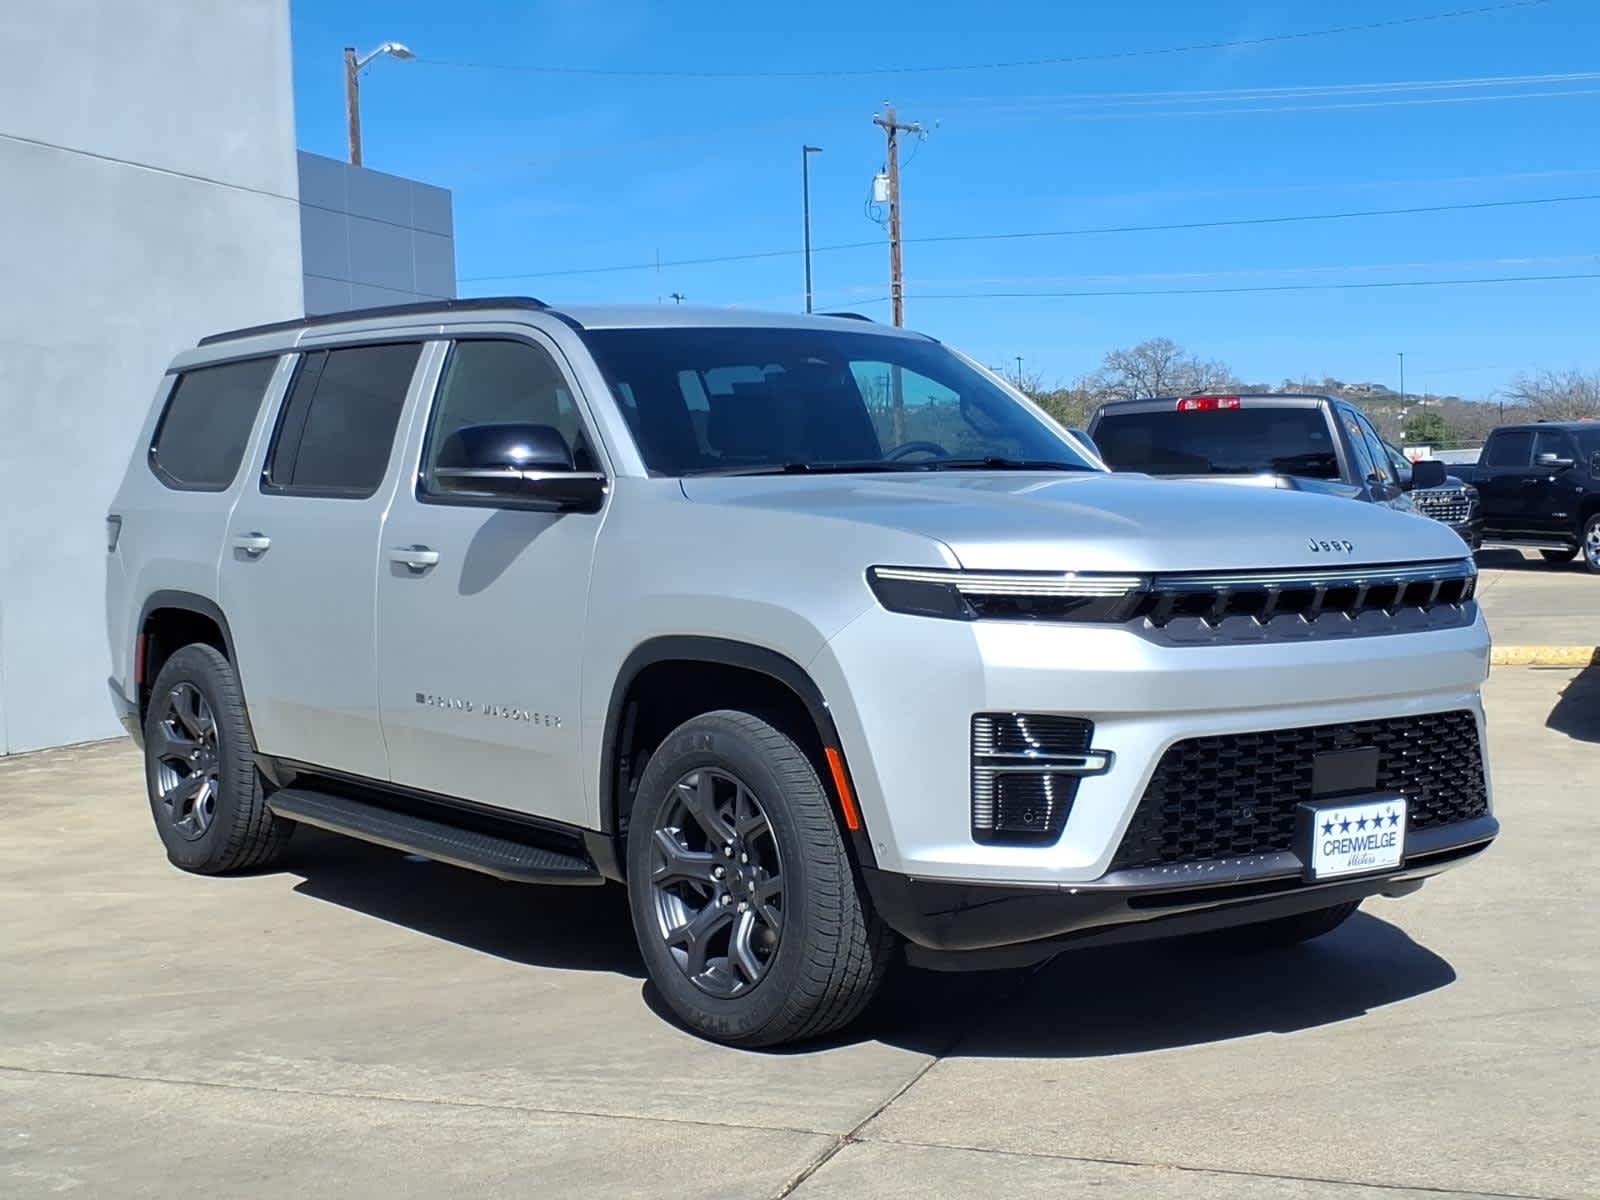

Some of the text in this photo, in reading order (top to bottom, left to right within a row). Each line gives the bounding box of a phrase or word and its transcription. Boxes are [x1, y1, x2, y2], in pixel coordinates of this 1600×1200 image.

[1309, 538, 1353, 555] Jeep
[482, 703, 562, 728] WAGONEER
[1323, 832, 1396, 856] CRENWELGE
